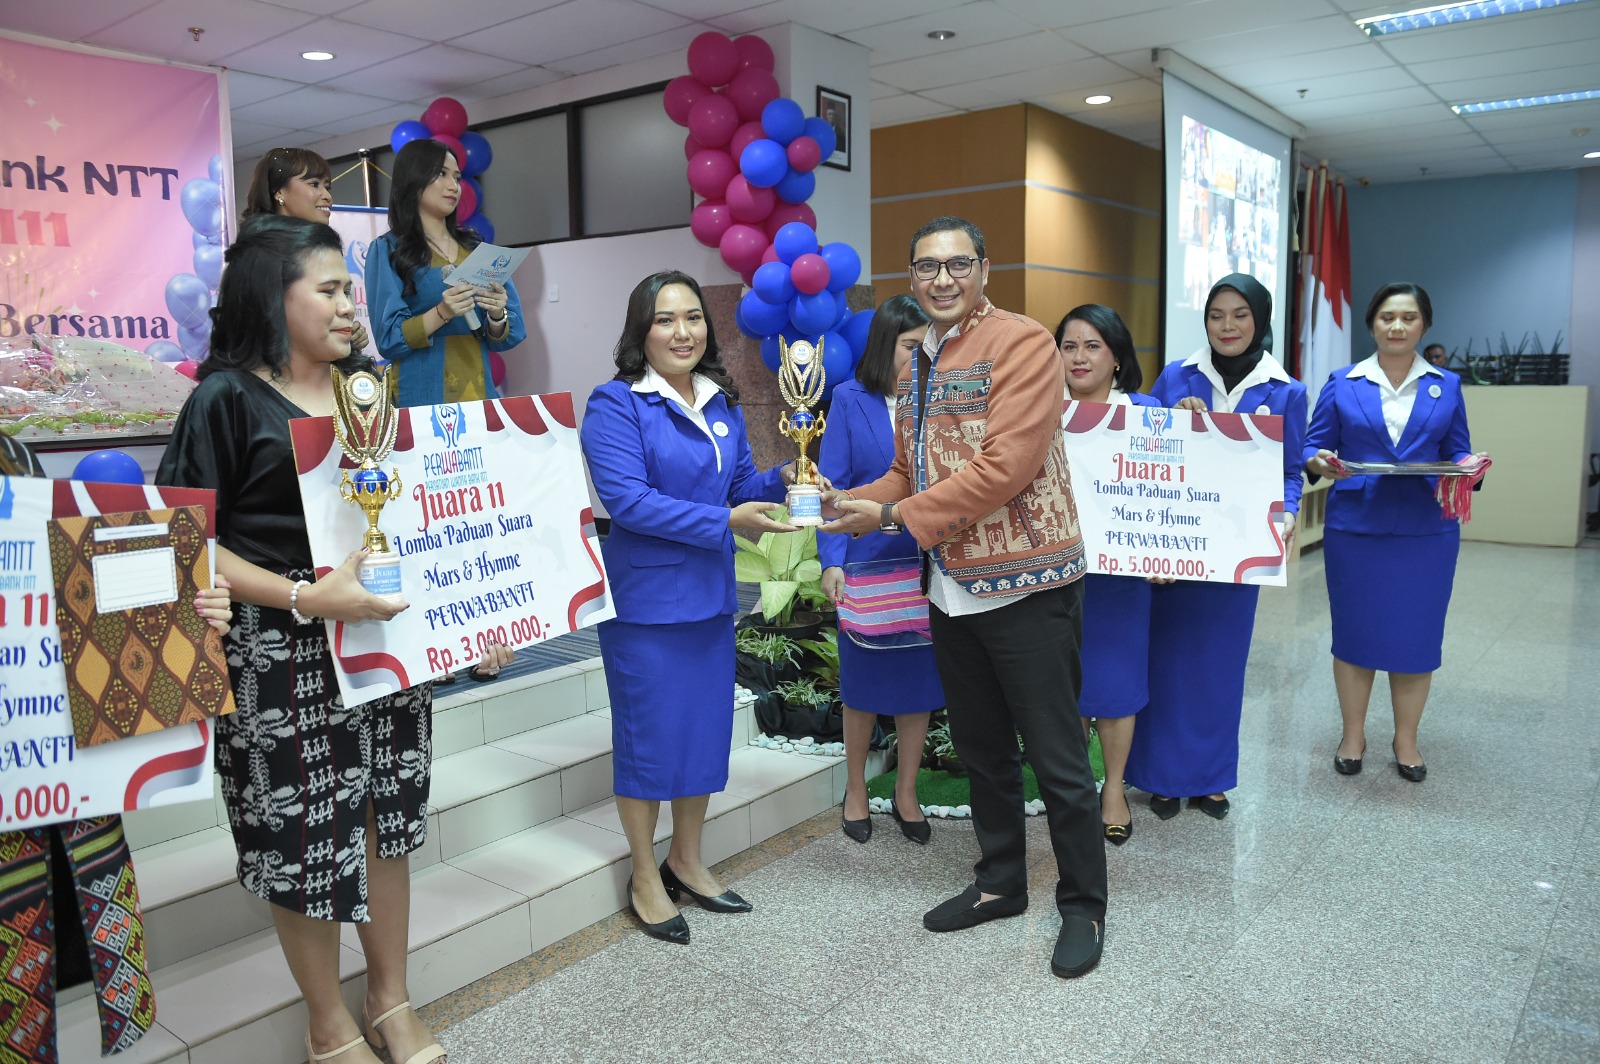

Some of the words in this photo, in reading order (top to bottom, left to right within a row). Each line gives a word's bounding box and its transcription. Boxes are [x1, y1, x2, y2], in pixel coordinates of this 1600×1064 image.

[84, 161, 178, 200] NTT
[0, 303, 171, 340] Bersama
[1129, 435, 1184, 454] PERWABANTT
[424, 446, 484, 478] PERWABANTT
[1111, 453, 1172, 483] Juara
[413, 483, 484, 533] Juara
[1094, 479, 1133, 498] Lomba
[1136, 483, 1181, 502] Paduan
[1186, 486, 1220, 503] Suara
[1111, 504, 1143, 523] Mars
[1145, 509, 1155, 523] &
[1157, 507, 1202, 528] Hymne
[393, 529, 443, 557] Lomba
[443, 520, 494, 546] Paduan
[497, 513, 533, 537] Suara
[1105, 530, 1209, 551] PERWABANTT
[423, 562, 461, 591] Mars
[462, 560, 473, 581] &
[475, 550, 521, 583] Hymne
[1098, 553, 1123, 575] Rp.
[1128, 555, 1216, 581] 5.000.000,-
[425, 581, 535, 631] PERWABANTT
[426, 646, 459, 674] Rp.
[0, 734, 75, 772] ANTT
[0, 781, 90, 824] .000,-
